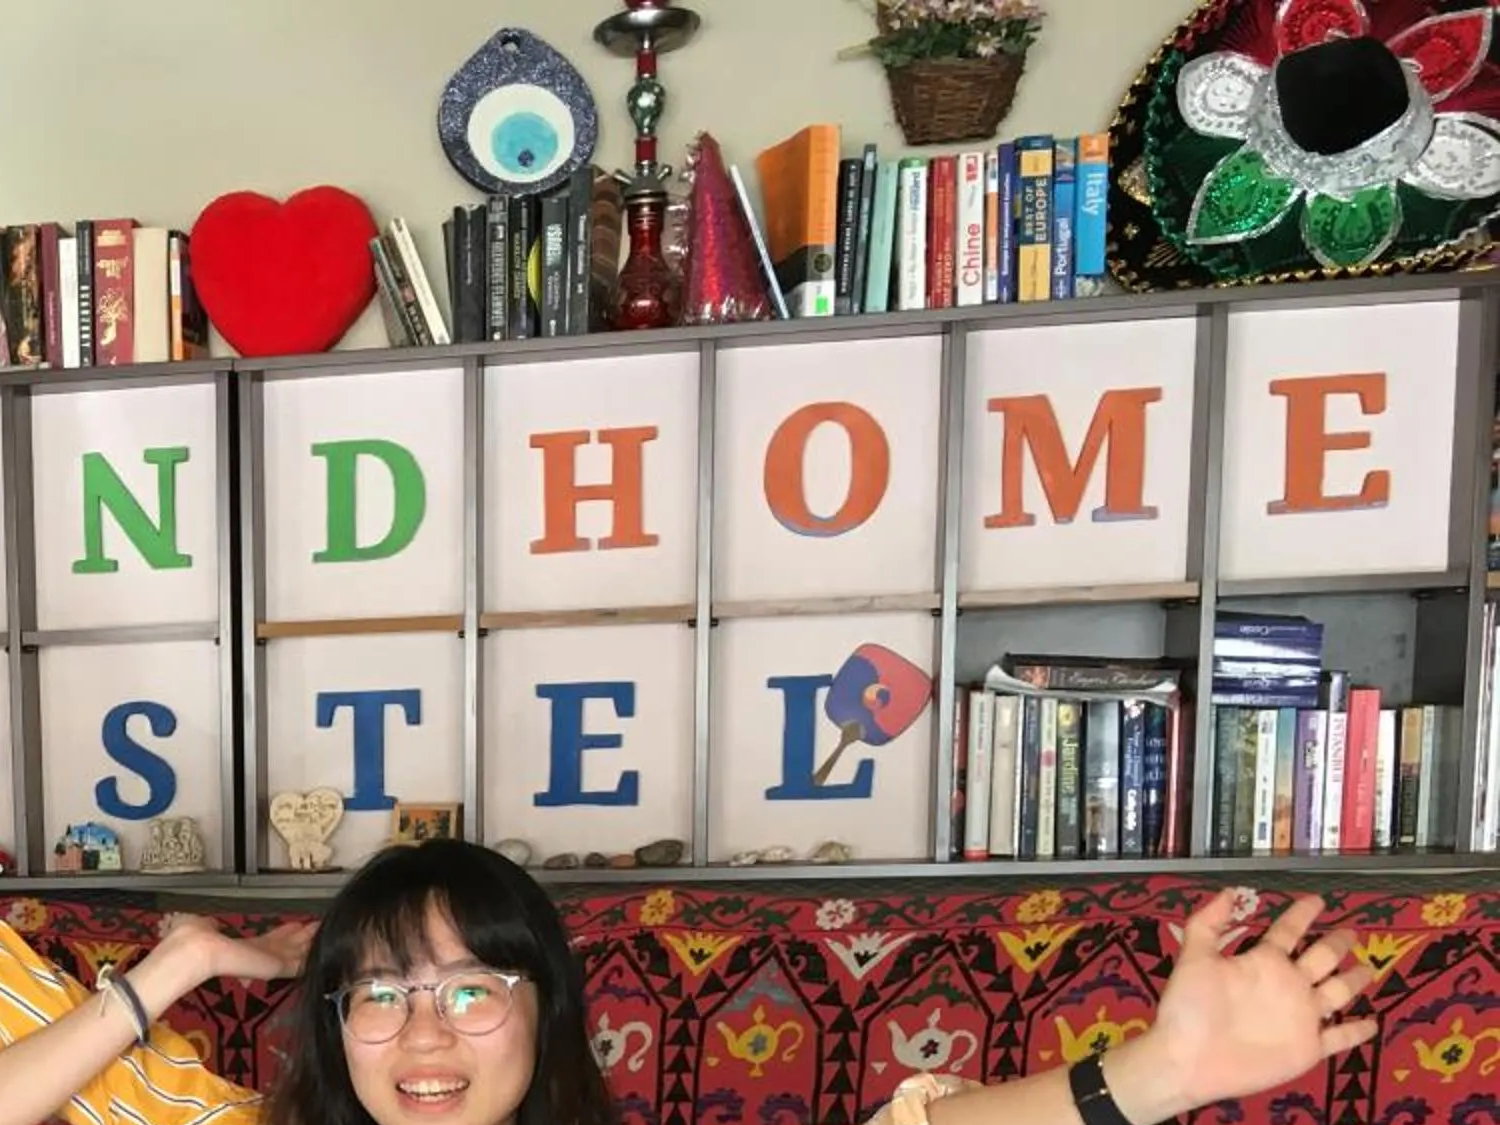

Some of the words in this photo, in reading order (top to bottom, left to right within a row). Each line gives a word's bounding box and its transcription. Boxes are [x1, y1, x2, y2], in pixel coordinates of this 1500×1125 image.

[1035, 177, 1048, 243] EUROPE
[1081, 172, 1105, 216] Italy
[961, 222, 981, 288] Chine
[1054, 217, 1072, 277] Portugal
[529, 373, 1390, 555] HOME
[1061, 736, 1079, 794] Jardine
